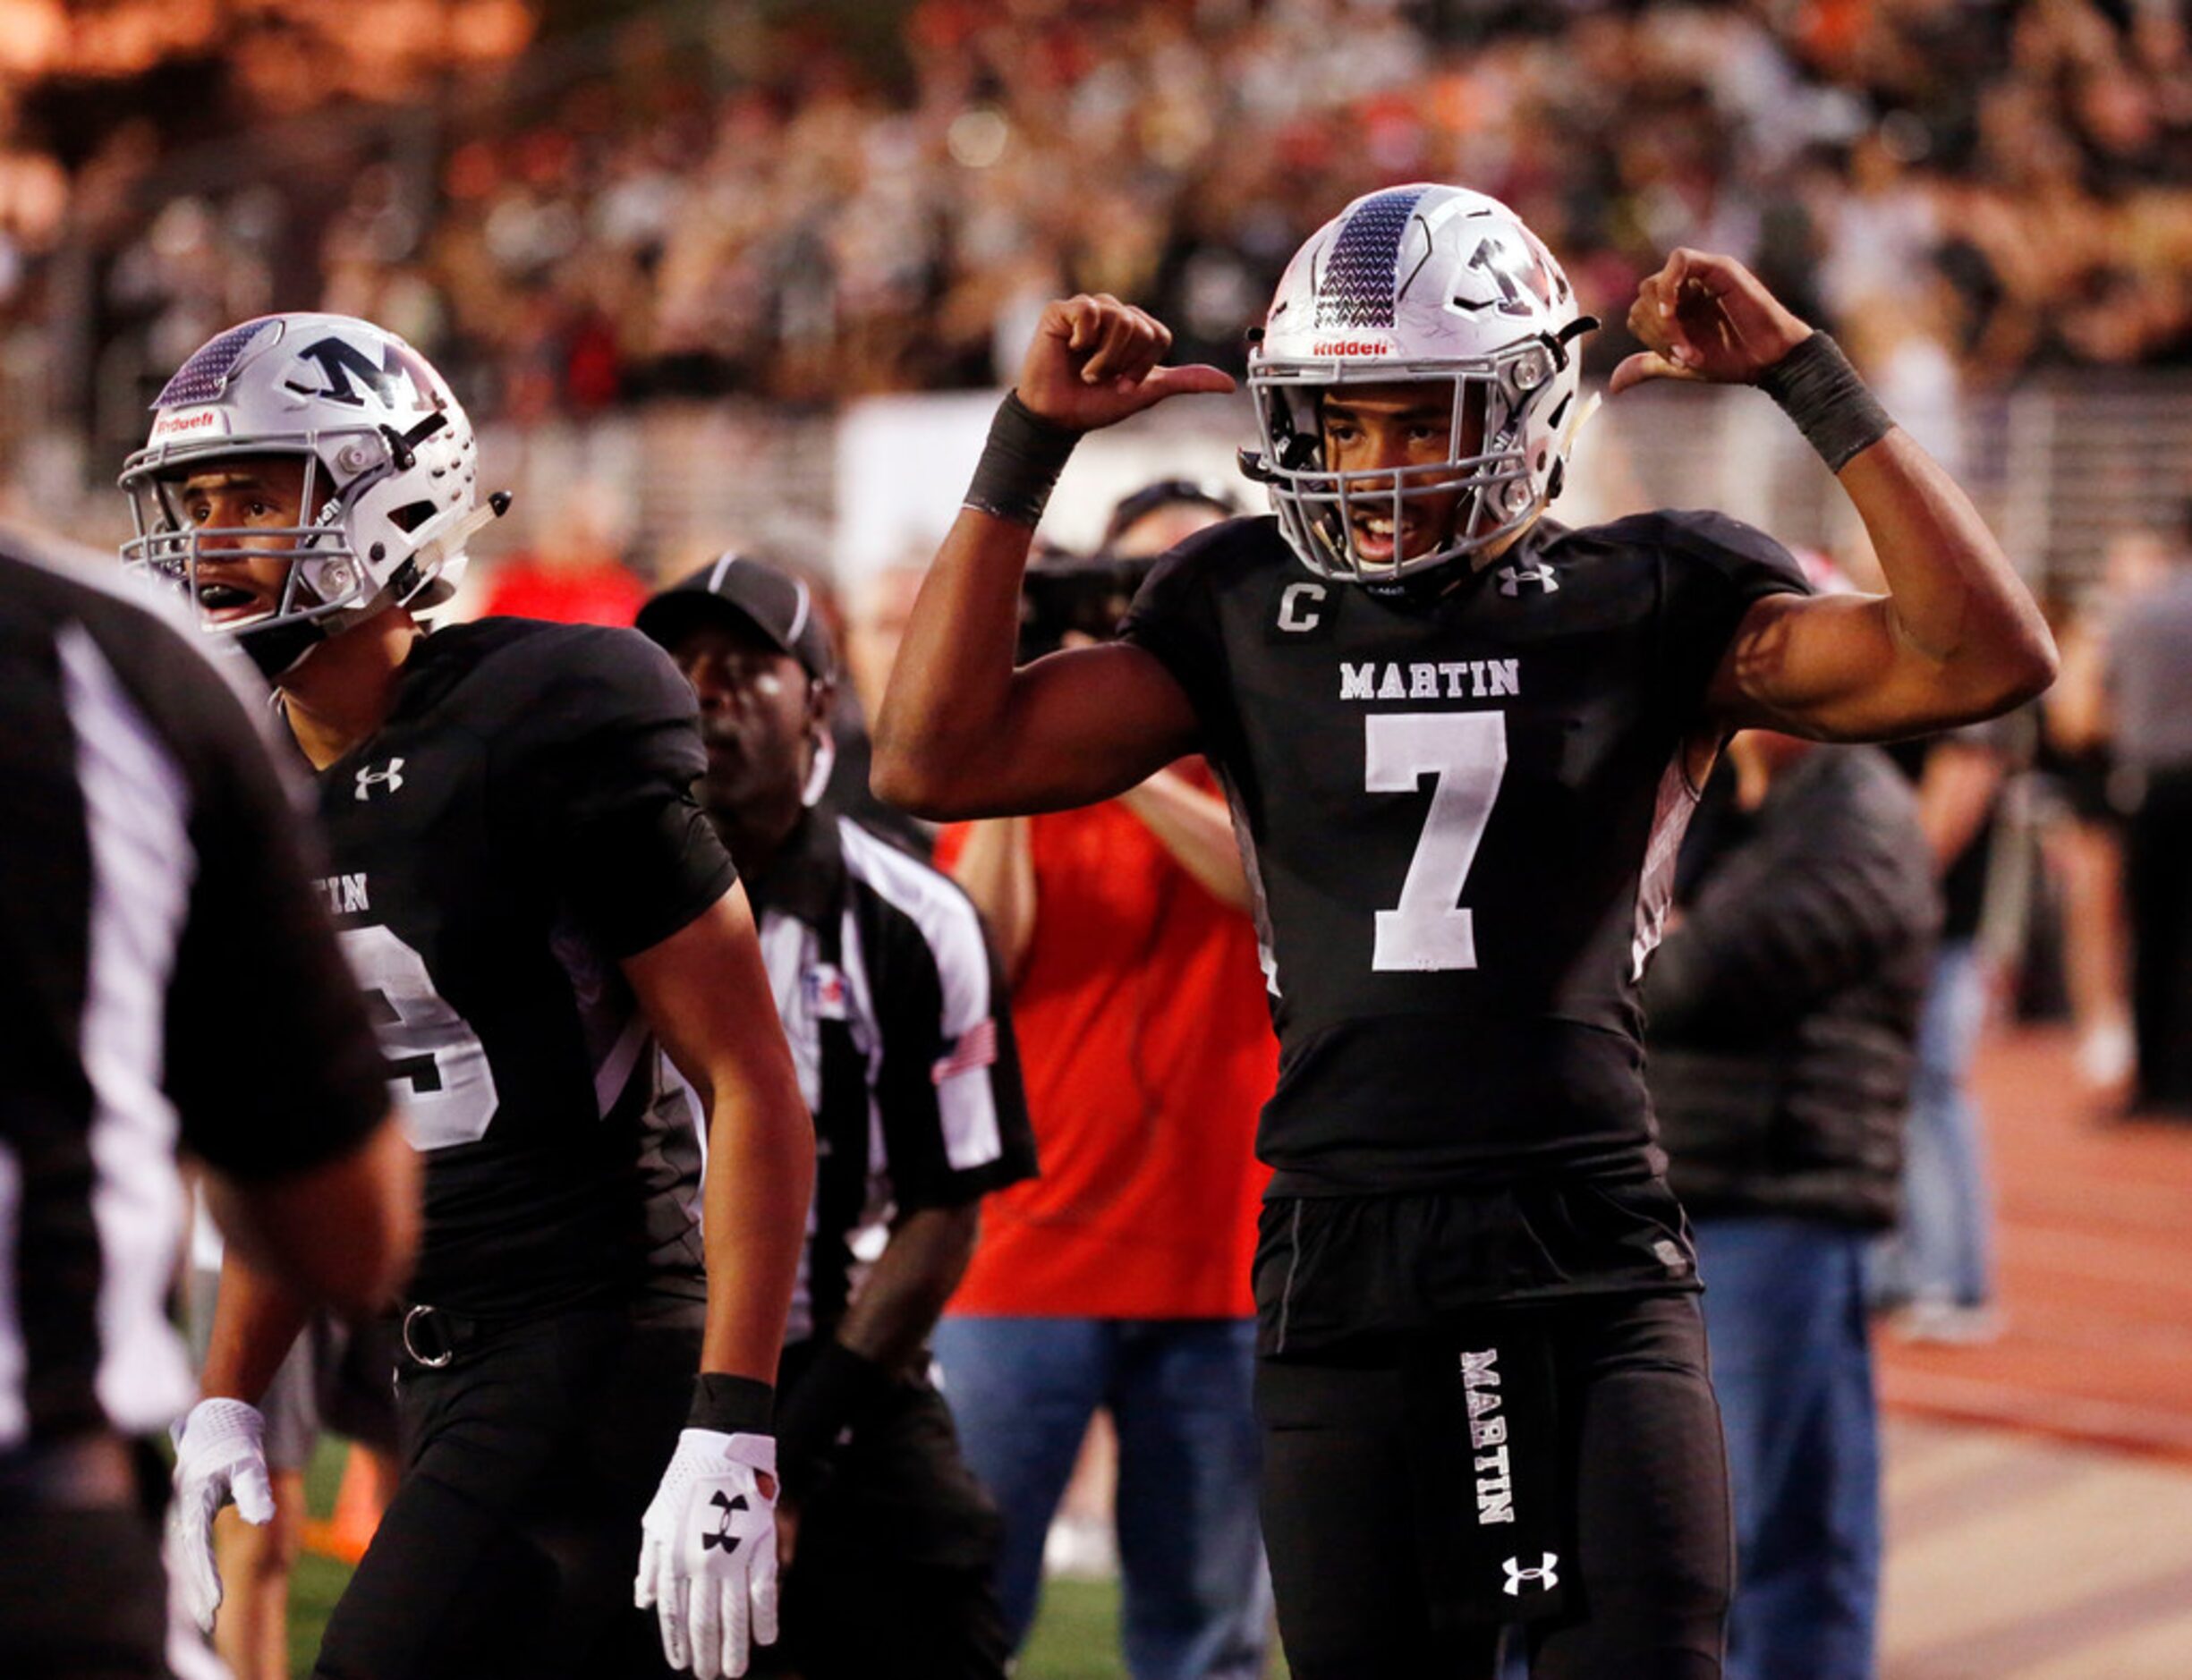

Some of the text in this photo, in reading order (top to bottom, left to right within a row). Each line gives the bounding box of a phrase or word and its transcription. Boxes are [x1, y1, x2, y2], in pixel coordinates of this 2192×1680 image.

[1278, 582, 1326, 632] C
[1339, 658, 1520, 700] MARTIN
[1365, 710, 1508, 972] 7
[1460, 1347, 1515, 1524] MARTIN
